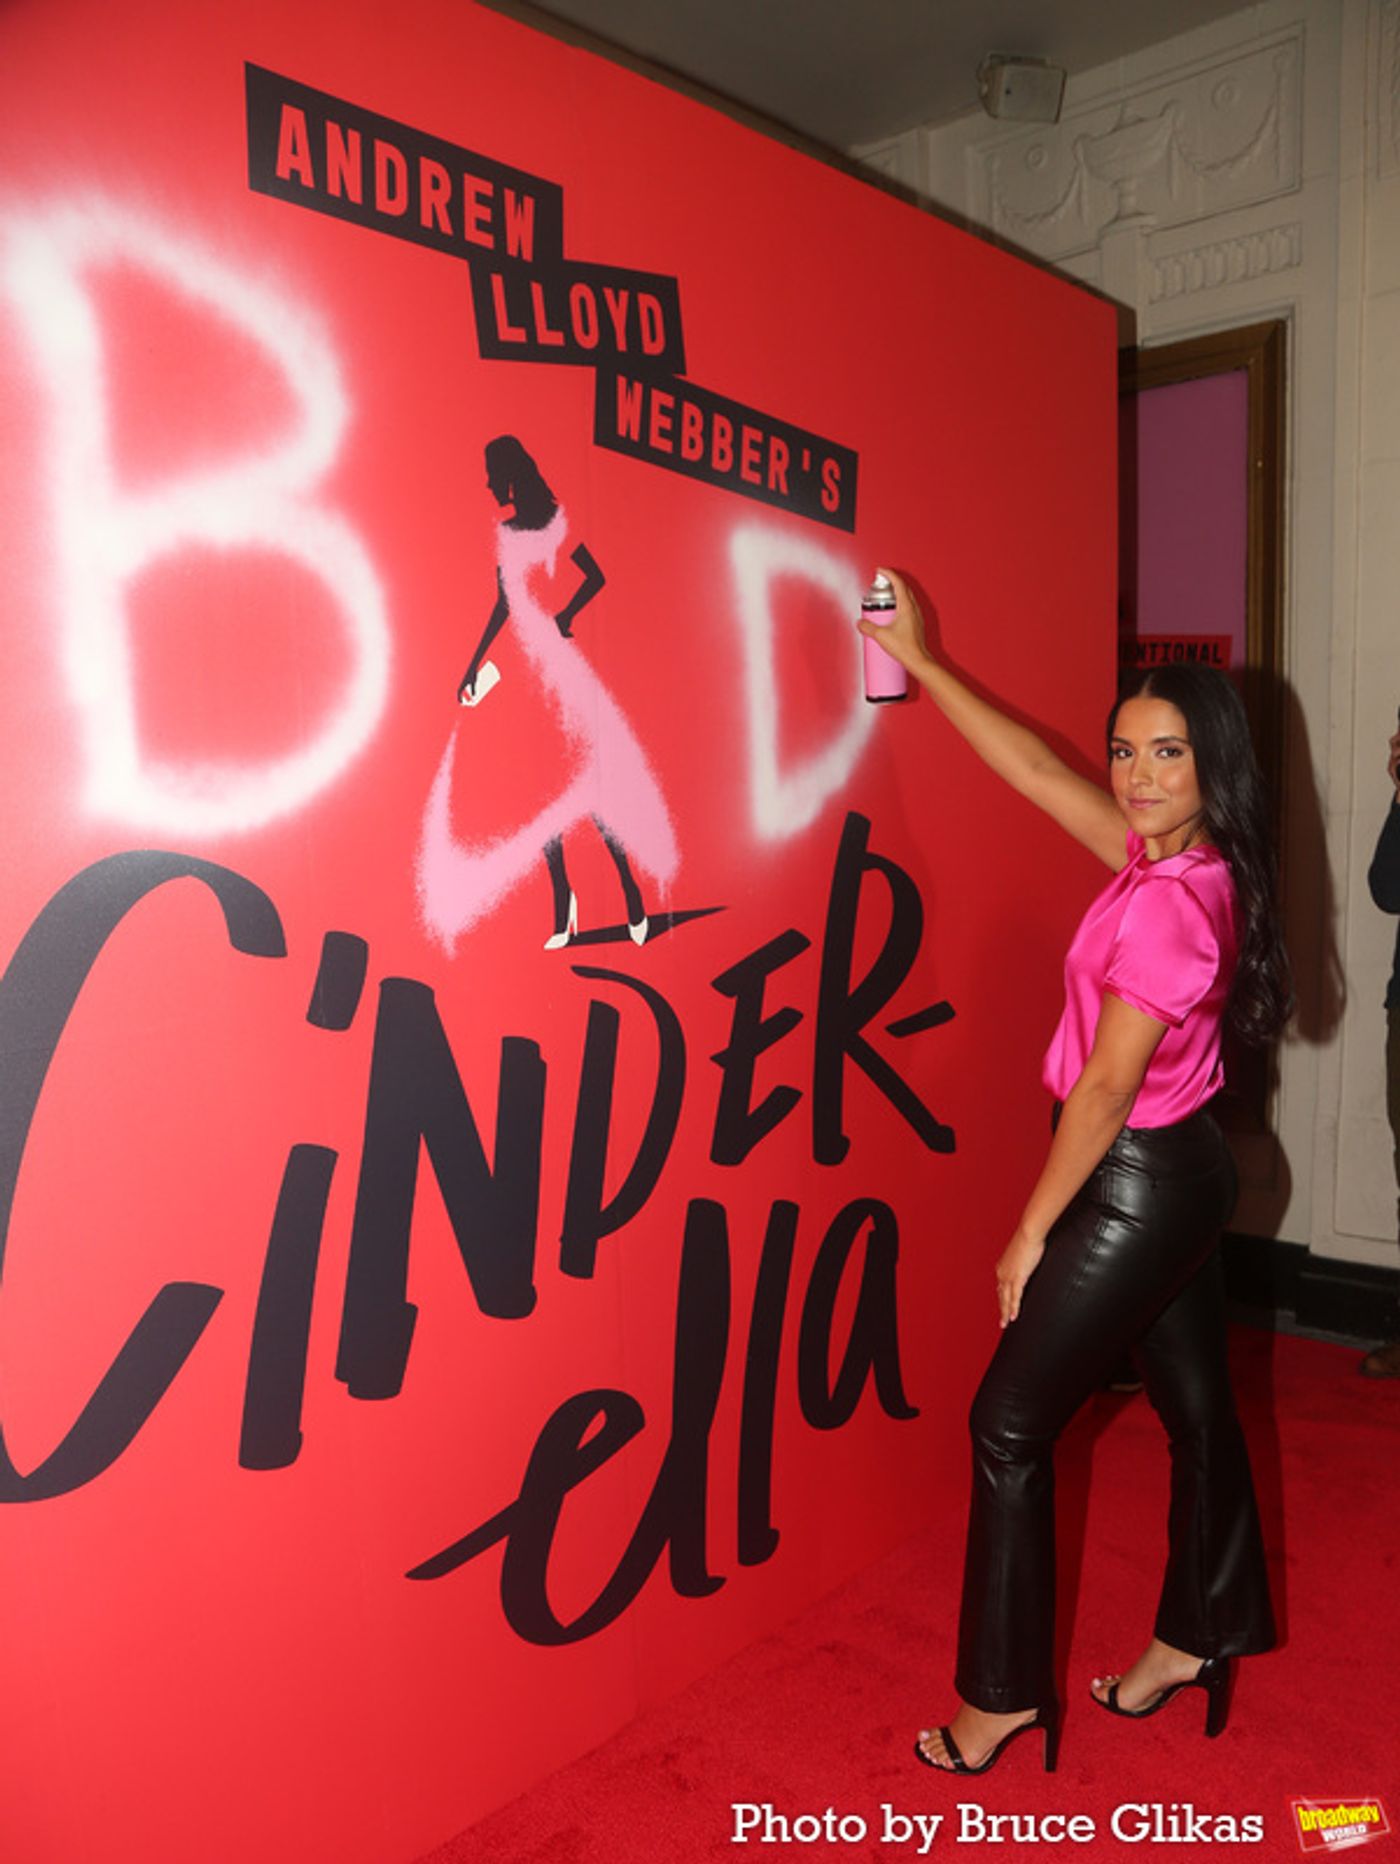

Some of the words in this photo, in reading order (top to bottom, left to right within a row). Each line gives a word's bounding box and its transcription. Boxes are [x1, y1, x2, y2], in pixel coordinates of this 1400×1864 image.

[275, 103, 535, 262] ANDREW
[490, 273, 666, 356] LLOYD
[616, 374, 841, 514] WEBBER'S
[404, 1197, 921, 1647] ella
